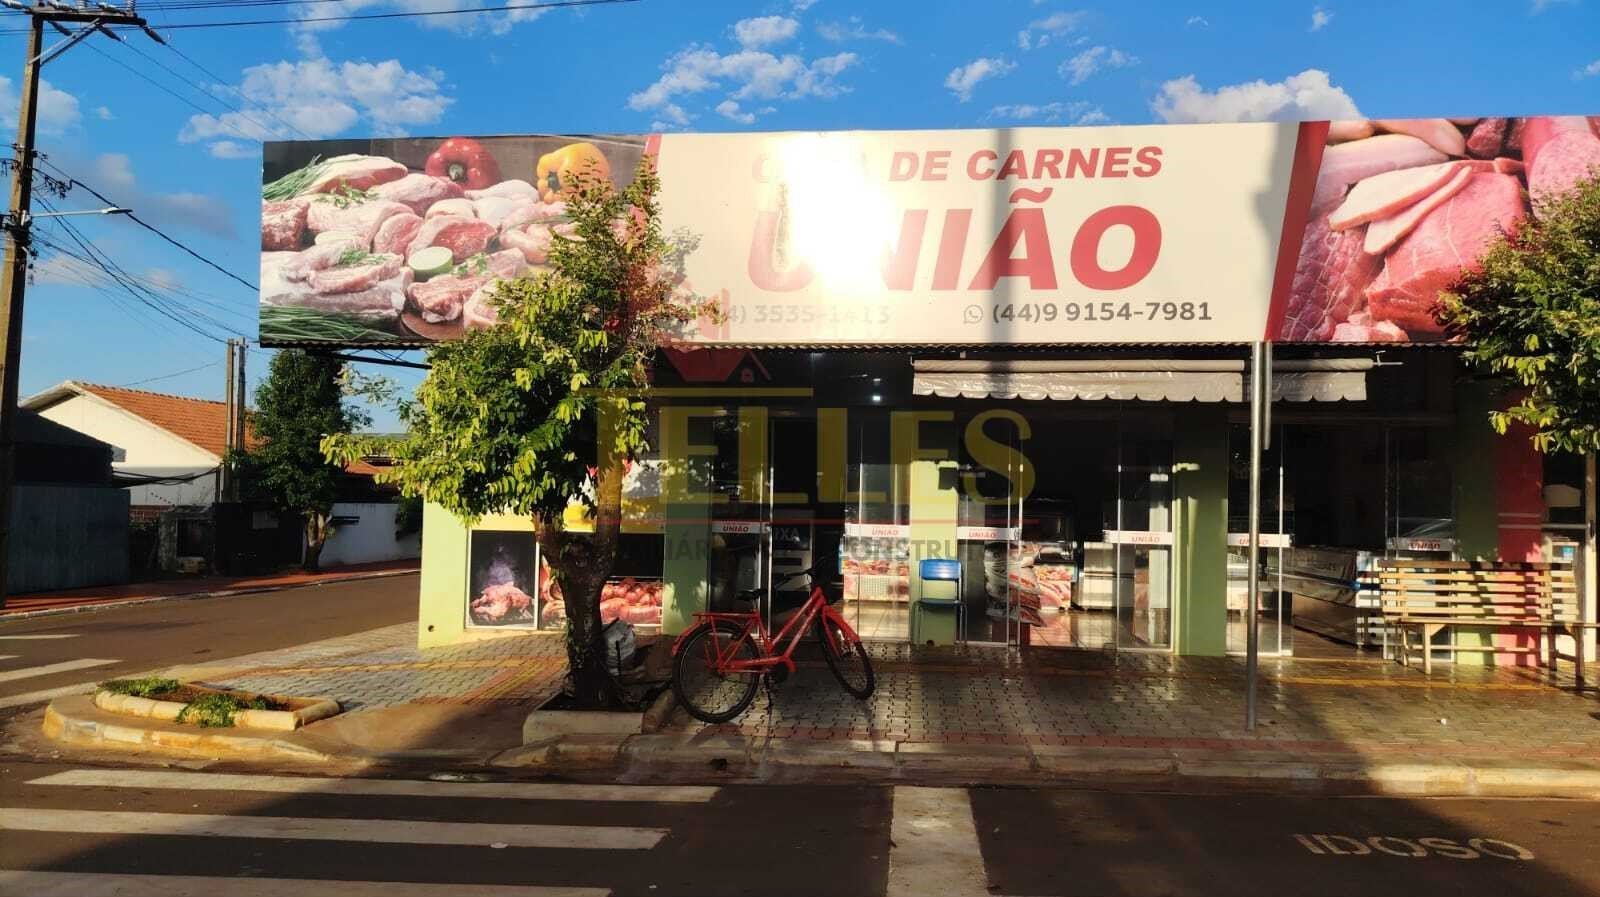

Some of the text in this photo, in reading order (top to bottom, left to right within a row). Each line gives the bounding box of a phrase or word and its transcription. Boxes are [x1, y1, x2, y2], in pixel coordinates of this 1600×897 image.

[888, 150, 952, 183] DE
[965, 146, 1163, 181] CARNES
[747, 187, 1163, 293] UNIÃO
[992, 302, 1213, 323] (44)9 9154-7981
[1293, 833, 1536, 860] IDOSO
